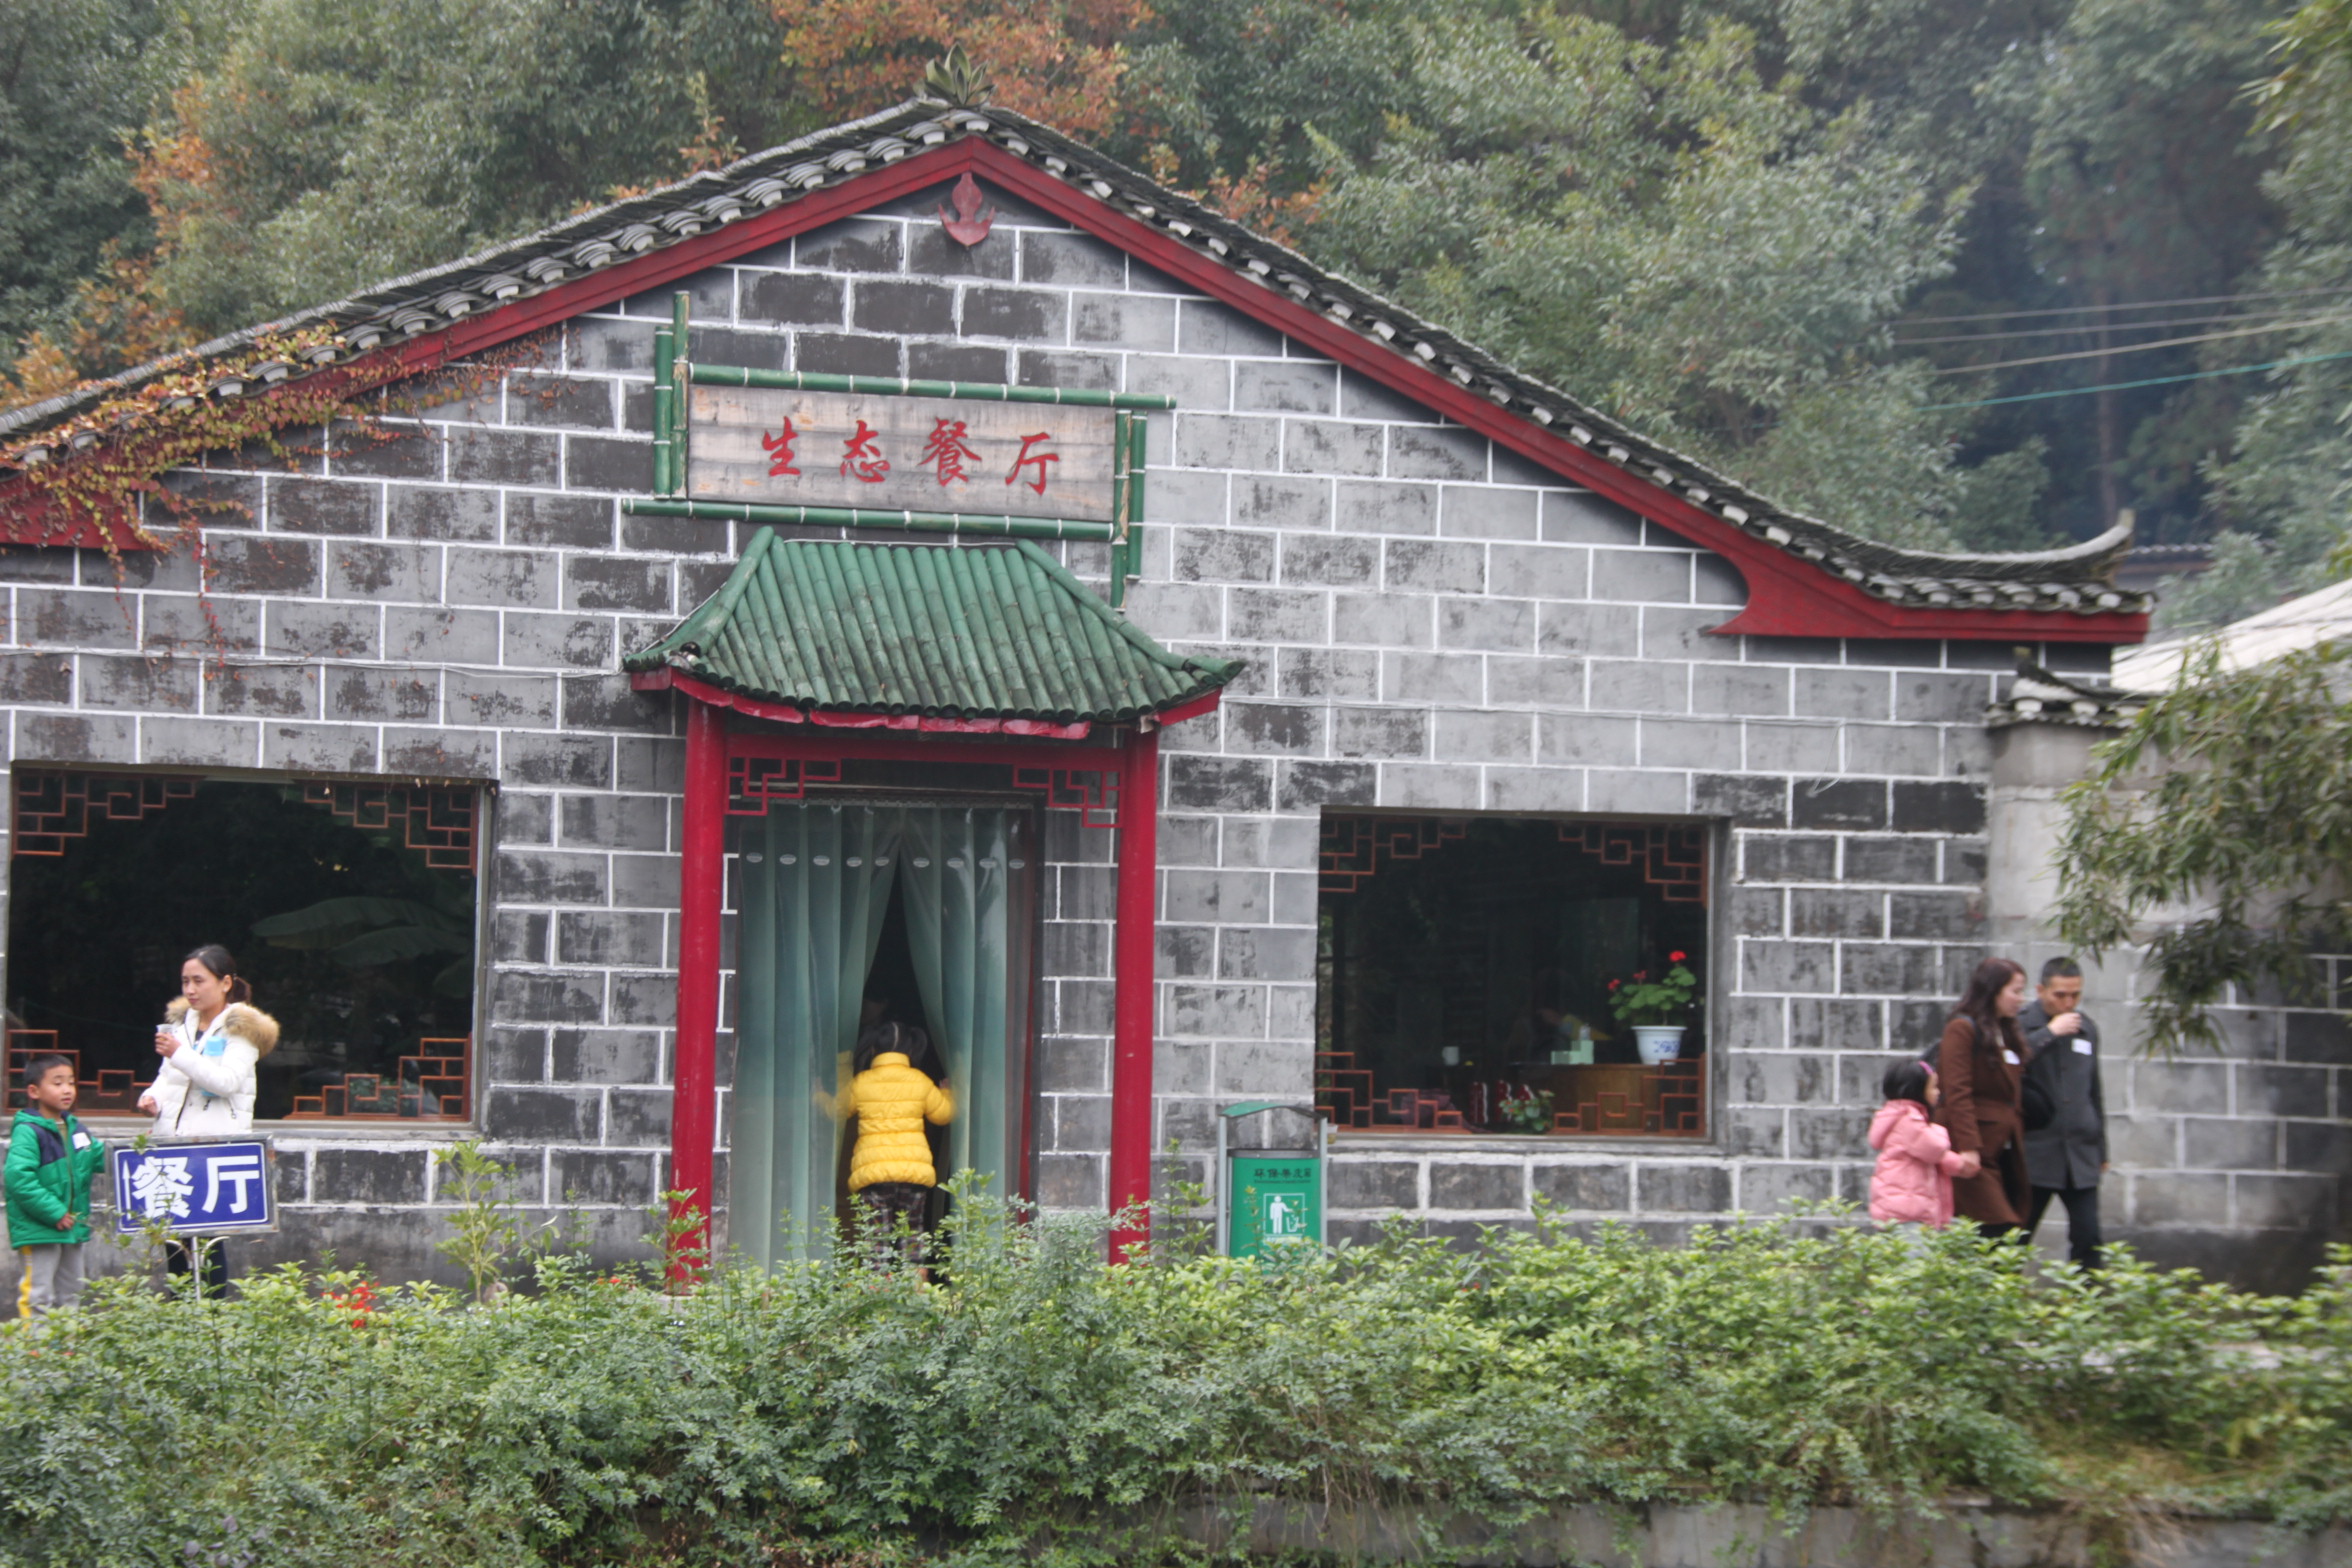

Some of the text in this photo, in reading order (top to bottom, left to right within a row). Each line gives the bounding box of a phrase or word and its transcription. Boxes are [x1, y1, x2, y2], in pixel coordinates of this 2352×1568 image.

[762, 416, 1059, 496] 生态餐厅
[131, 1155, 260, 1219] 餐厅
